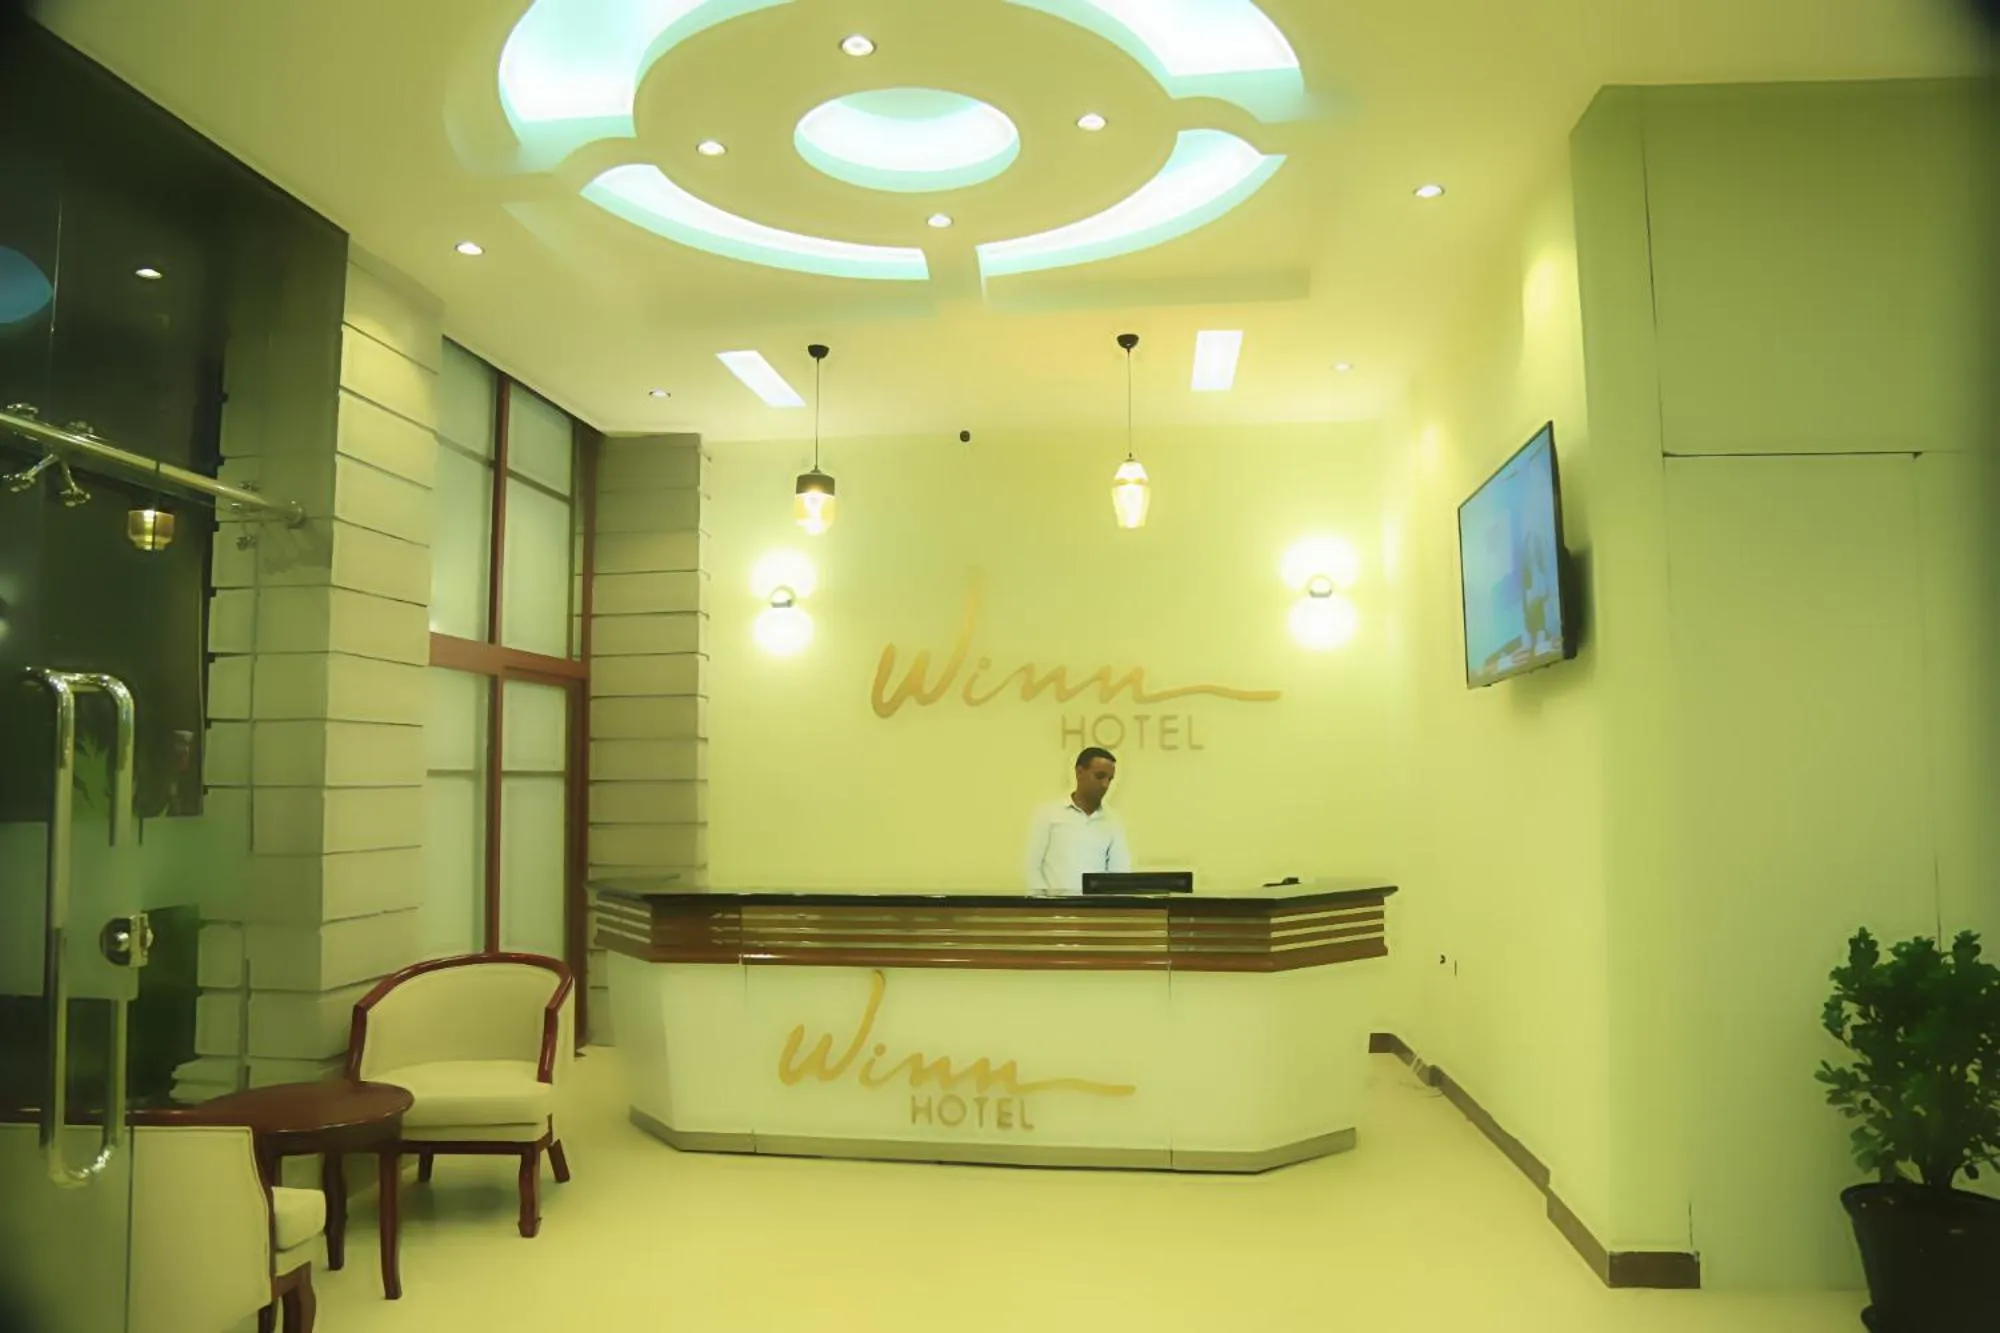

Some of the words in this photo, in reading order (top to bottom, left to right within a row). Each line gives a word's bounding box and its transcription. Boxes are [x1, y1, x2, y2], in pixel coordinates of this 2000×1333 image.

[871, 566, 1282, 718] Winn
[1061, 713, 1205, 750] HOTEL
[778, 969, 1137, 1097] Winn
[910, 1094, 1035, 1130] HOTEL
